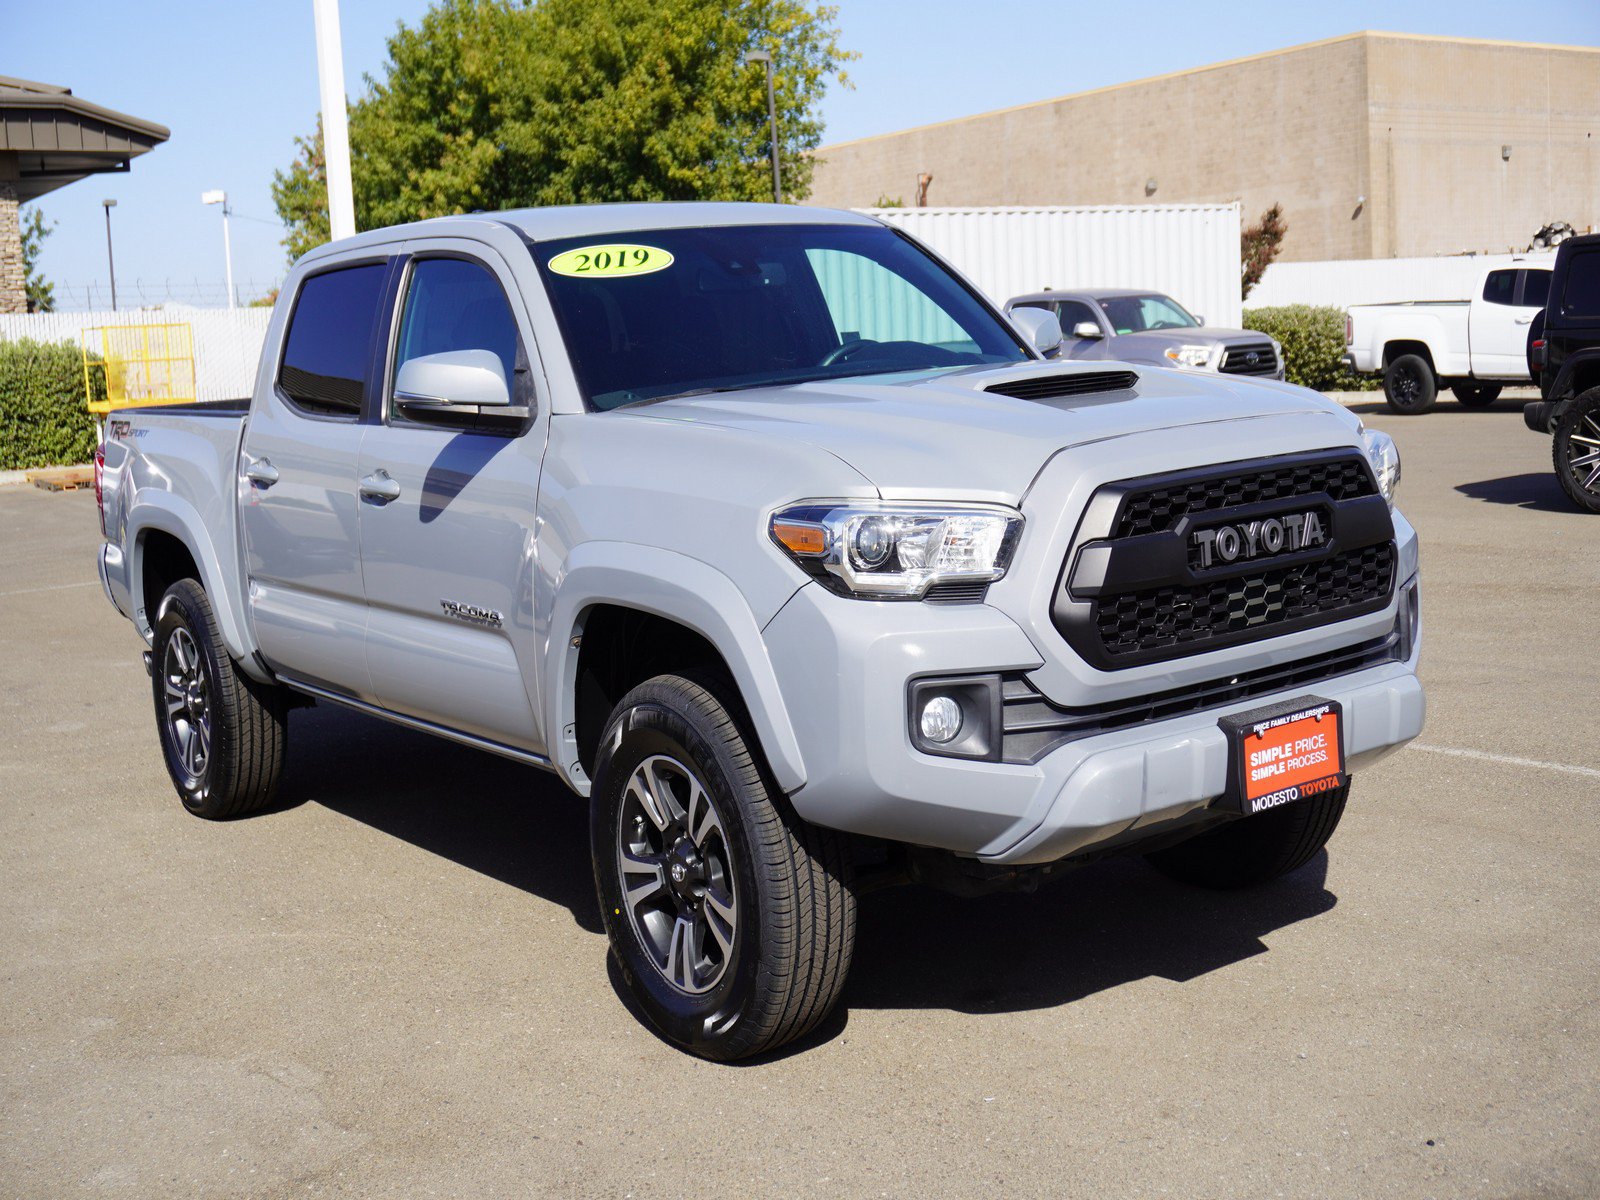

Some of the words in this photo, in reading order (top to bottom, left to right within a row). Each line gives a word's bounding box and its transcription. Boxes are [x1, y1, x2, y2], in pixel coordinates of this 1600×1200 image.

[574, 249, 650, 273] 2019
[110, 420, 131, 441] TRD
[1193, 511, 1325, 568] TOYOTA
[440, 599, 504, 622] TACOMA
[1253, 721, 1270, 732] PRICE
[1270, 716, 1291, 727] FAMILY
[1290, 705, 1330, 723] DEALERSHIPS
[1250, 743, 1292, 767] SIMPLE
[1294, 733, 1328, 755] PRICE.
[1251, 761, 1286, 781] SIMPLE
[1287, 750, 1328, 772] PROCESS.
[1251, 787, 1299, 813] MODESTO
[1299, 775, 1340, 797] TOYOTA
